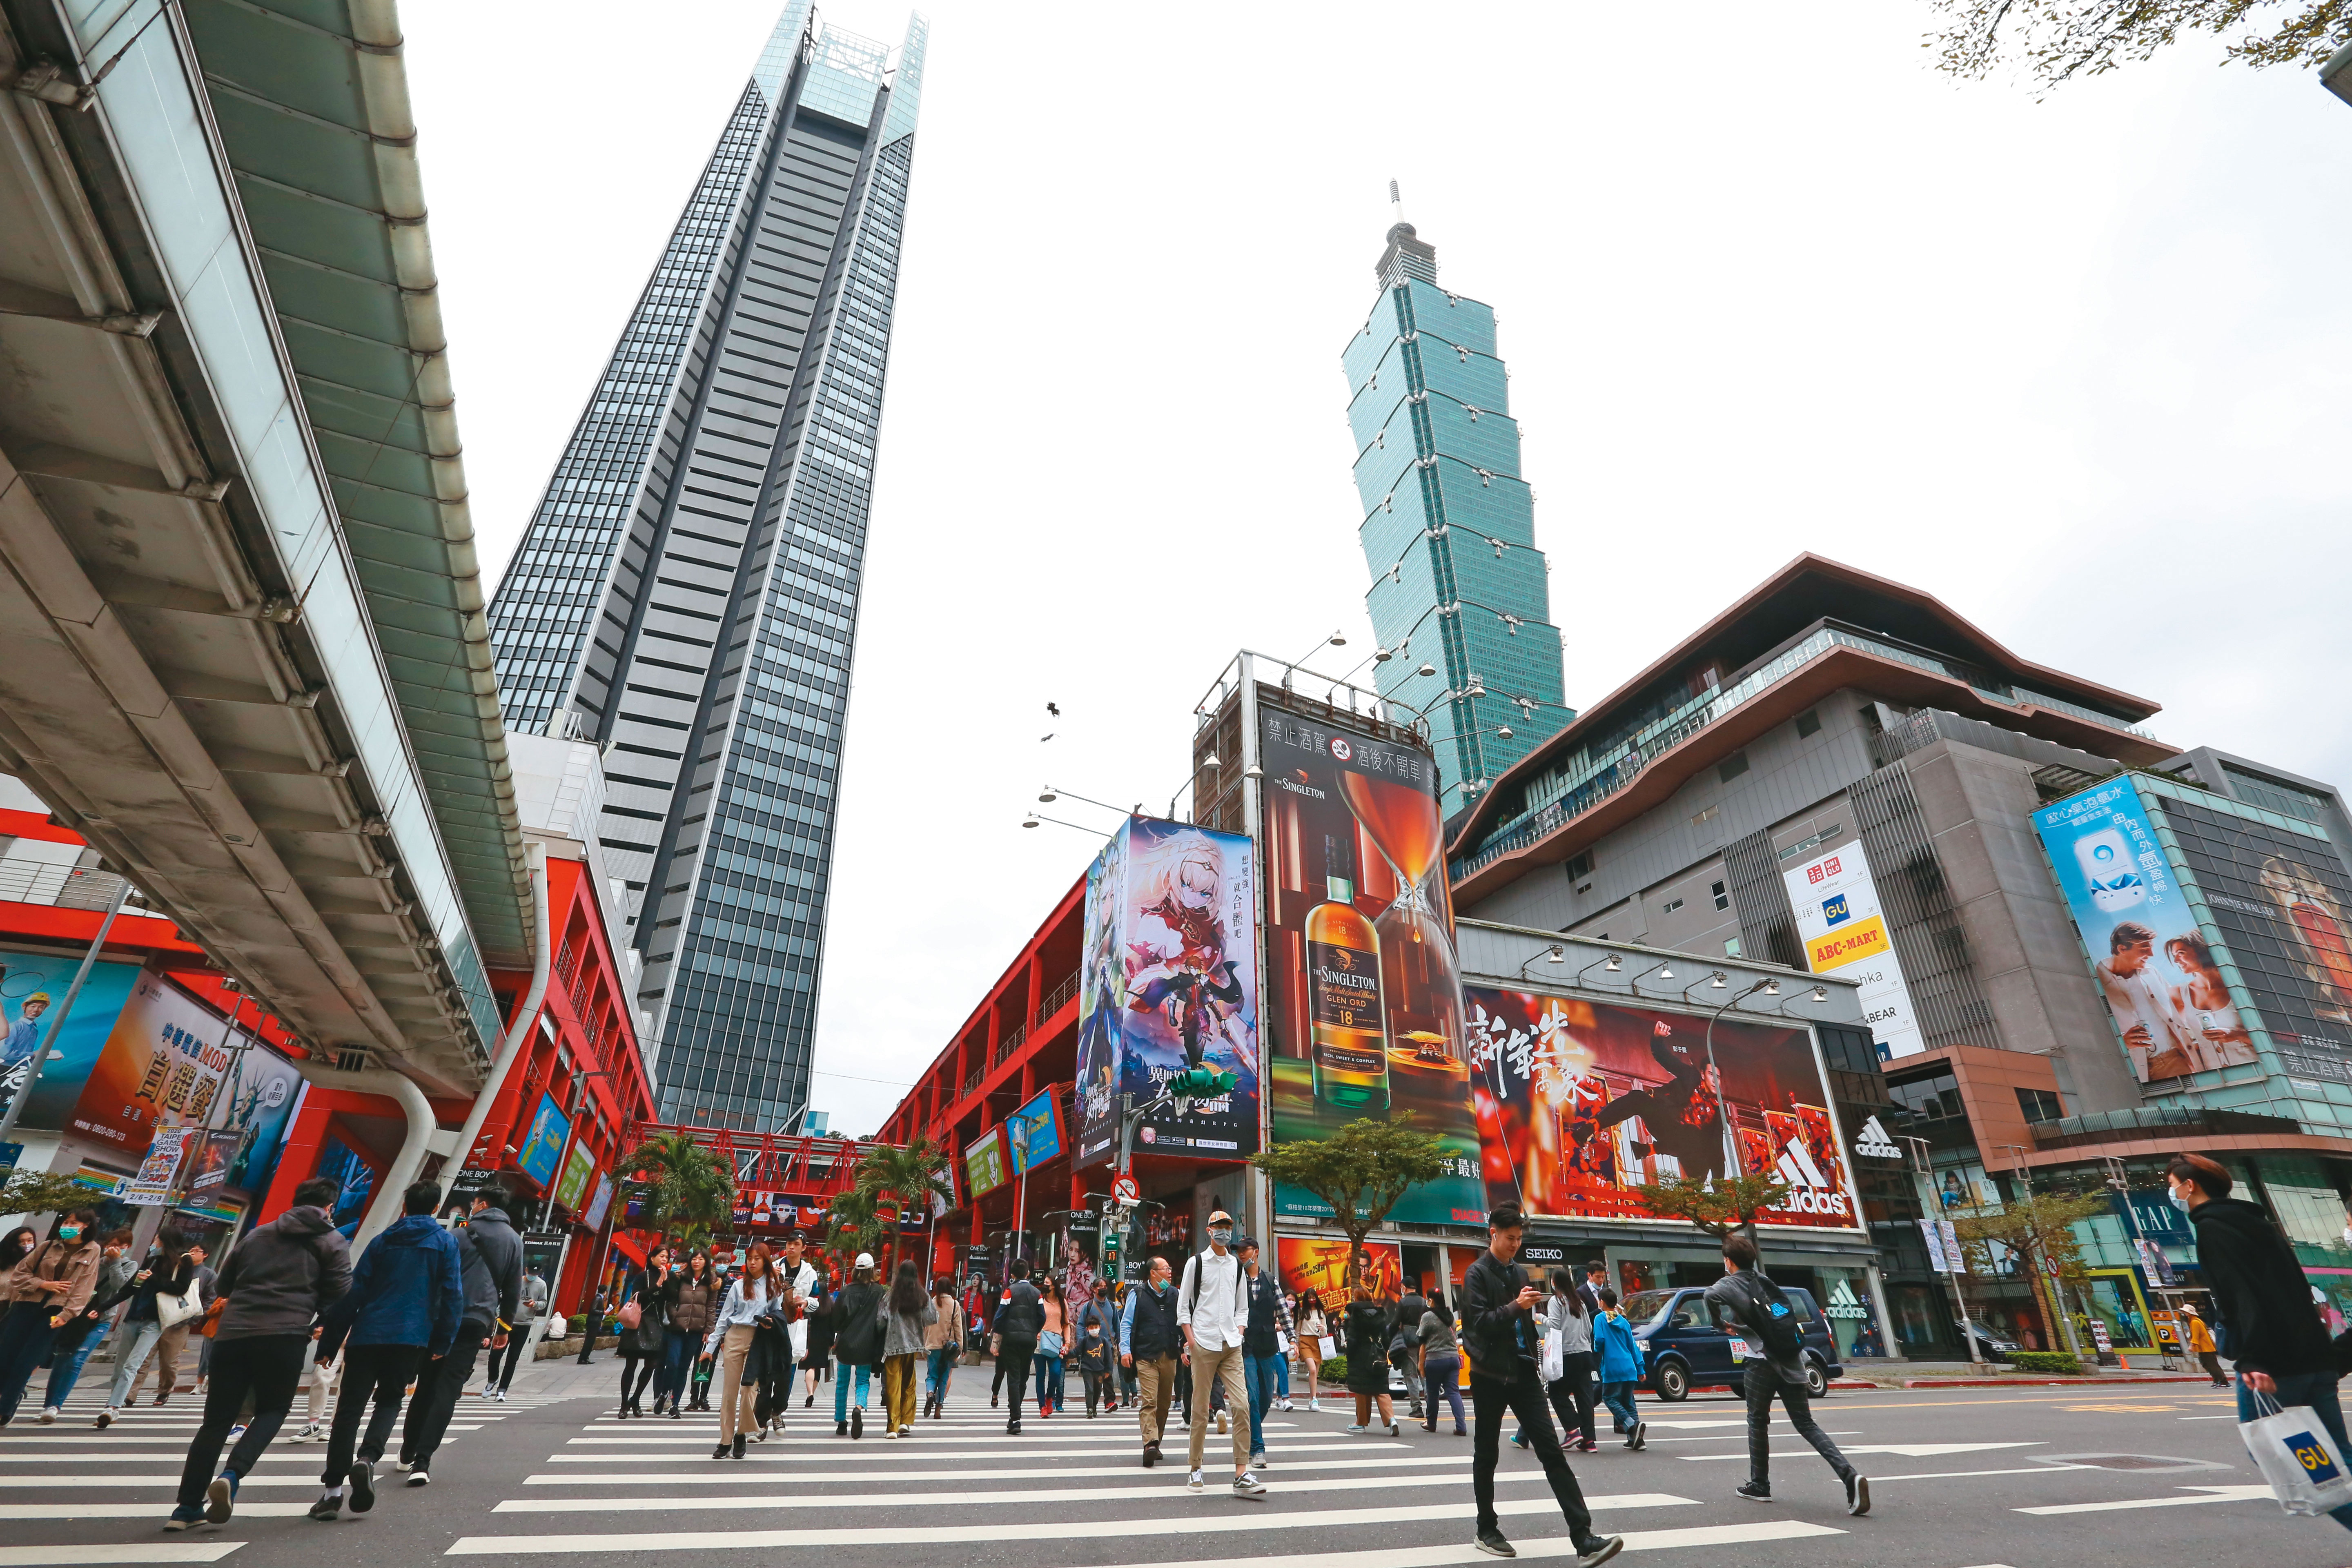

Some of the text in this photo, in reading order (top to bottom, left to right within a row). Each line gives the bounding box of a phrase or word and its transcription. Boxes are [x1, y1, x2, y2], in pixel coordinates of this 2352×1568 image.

[1268, 717, 1326, 756] 禁止酒駕
[1356, 743, 1420, 782] 酒後不開車
[1282, 778, 1325, 800] SINGLETON
[1825, 859, 1837, 868] UNI
[1828, 865, 1840, 875] QLO
[1818, 880, 1840, 893] LifeWear
[1826, 901, 1847, 918] GU
[2207, 893, 2276, 917] JOHNNIE WALKER
[1339, 926, 1346, 934] 18
[1817, 929, 1878, 962] ABC-MART
[1327, 995, 1366, 1007] GLEN ORD
[1340, 1010, 1353, 1025] 18
[2283, 1049, 2348, 1079] 禁止酒駕
[1855, 1141, 1902, 1159] adidas
[2132, 1205, 2173, 1231] GAP
[1109, 1252, 1116, 1260] 17
[1526, 1248, 1563, 1259] SEIKO
[1825, 1303, 1867, 1319] adidas
[2295, 1444, 2330, 1470] GU
